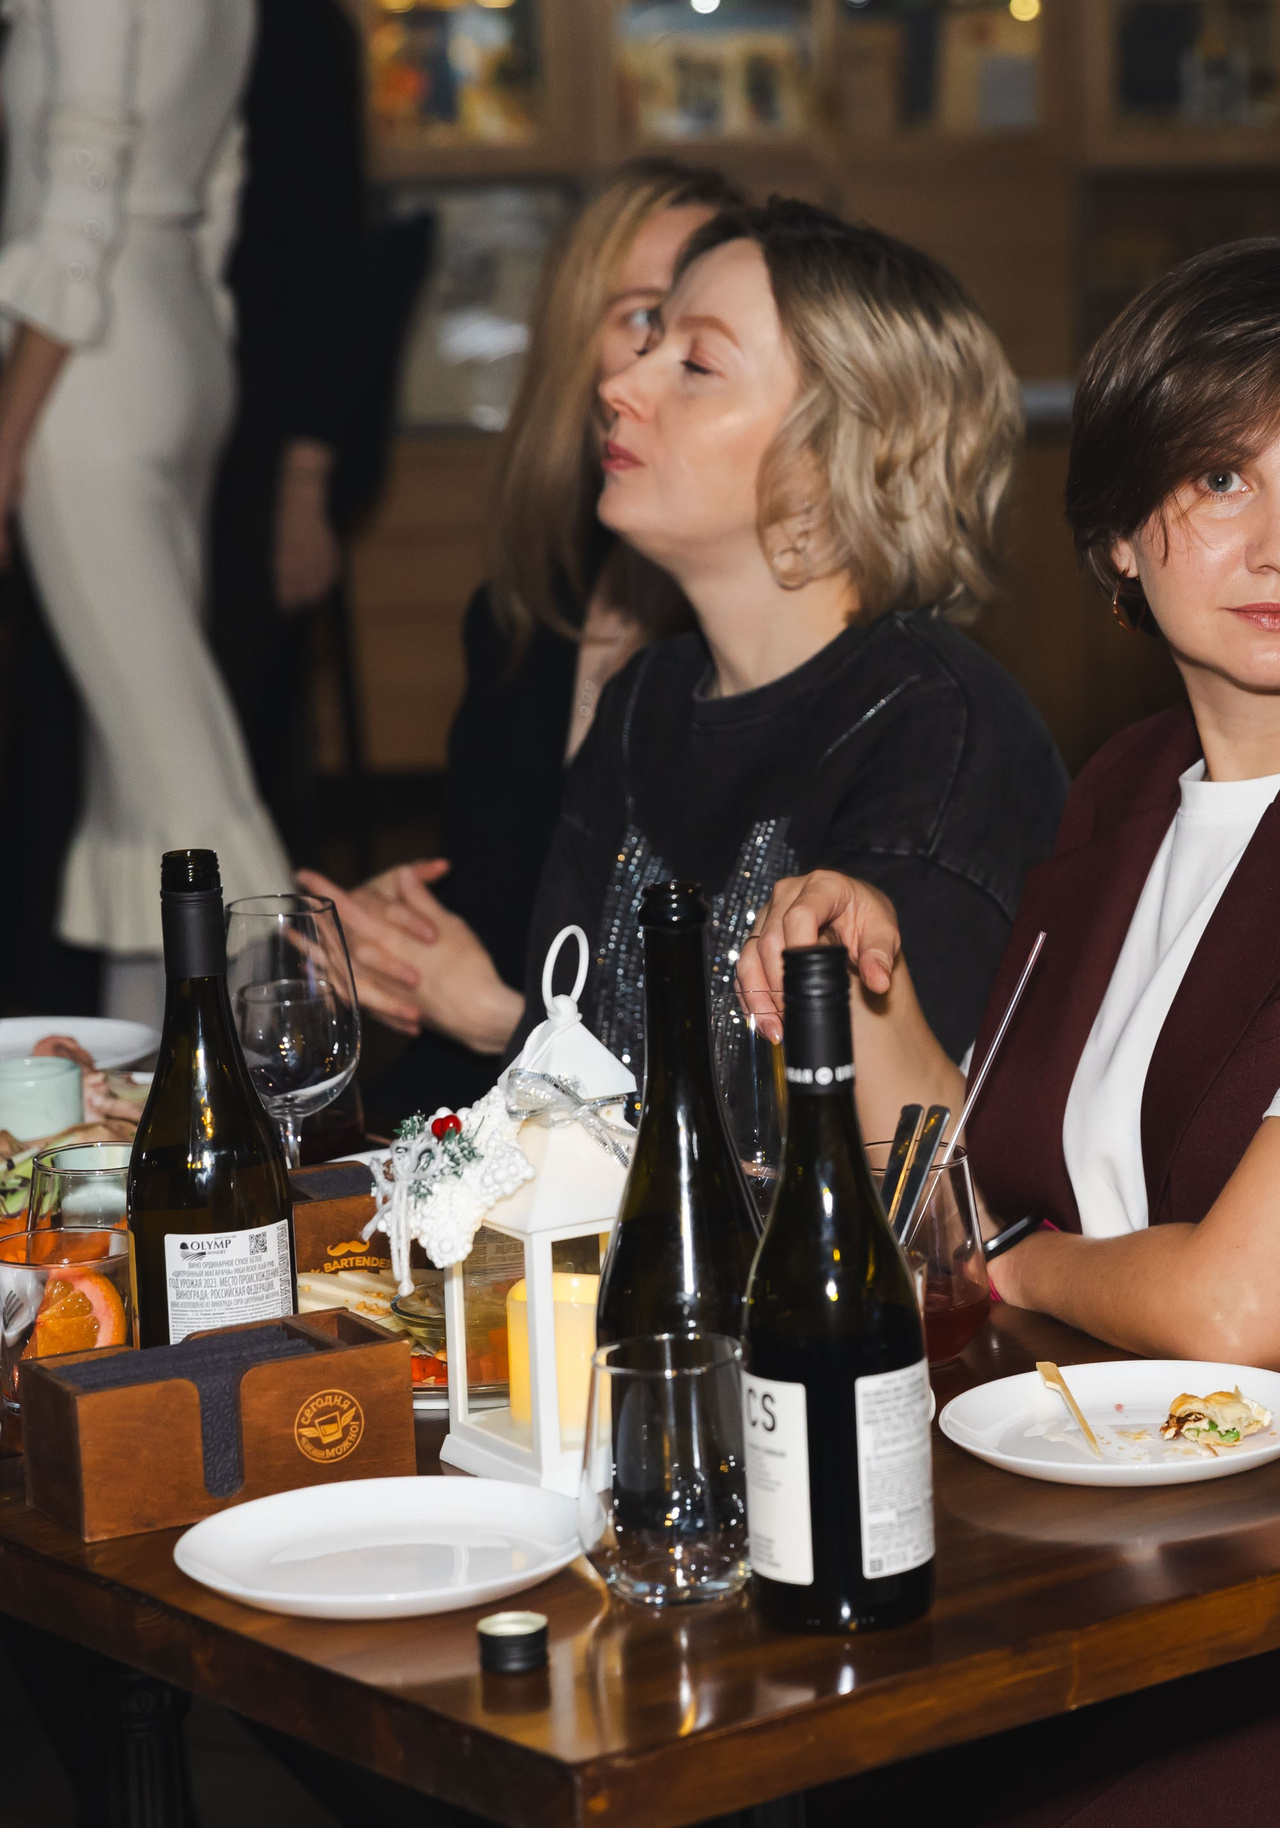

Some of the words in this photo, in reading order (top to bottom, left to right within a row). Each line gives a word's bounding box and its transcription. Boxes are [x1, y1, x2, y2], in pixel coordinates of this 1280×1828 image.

[190, 1239, 231, 1250] OLYMP
[188, 1261, 201, 1269] ВИНО
[203, 1259, 234, 1269] ОРДИНАРНОЕ
[169, 1277, 179, 1289] ГОД
[180, 1278, 202, 1288] УРОЖАЯ
[203, 1278, 218, 1288] 2023.
[219, 1275, 237, 1288] МЕСТО
[176, 1289, 210, 1301] ВИНОГРАДА:
[210, 1286, 246, 1299] РОССИЙСКАЯ
